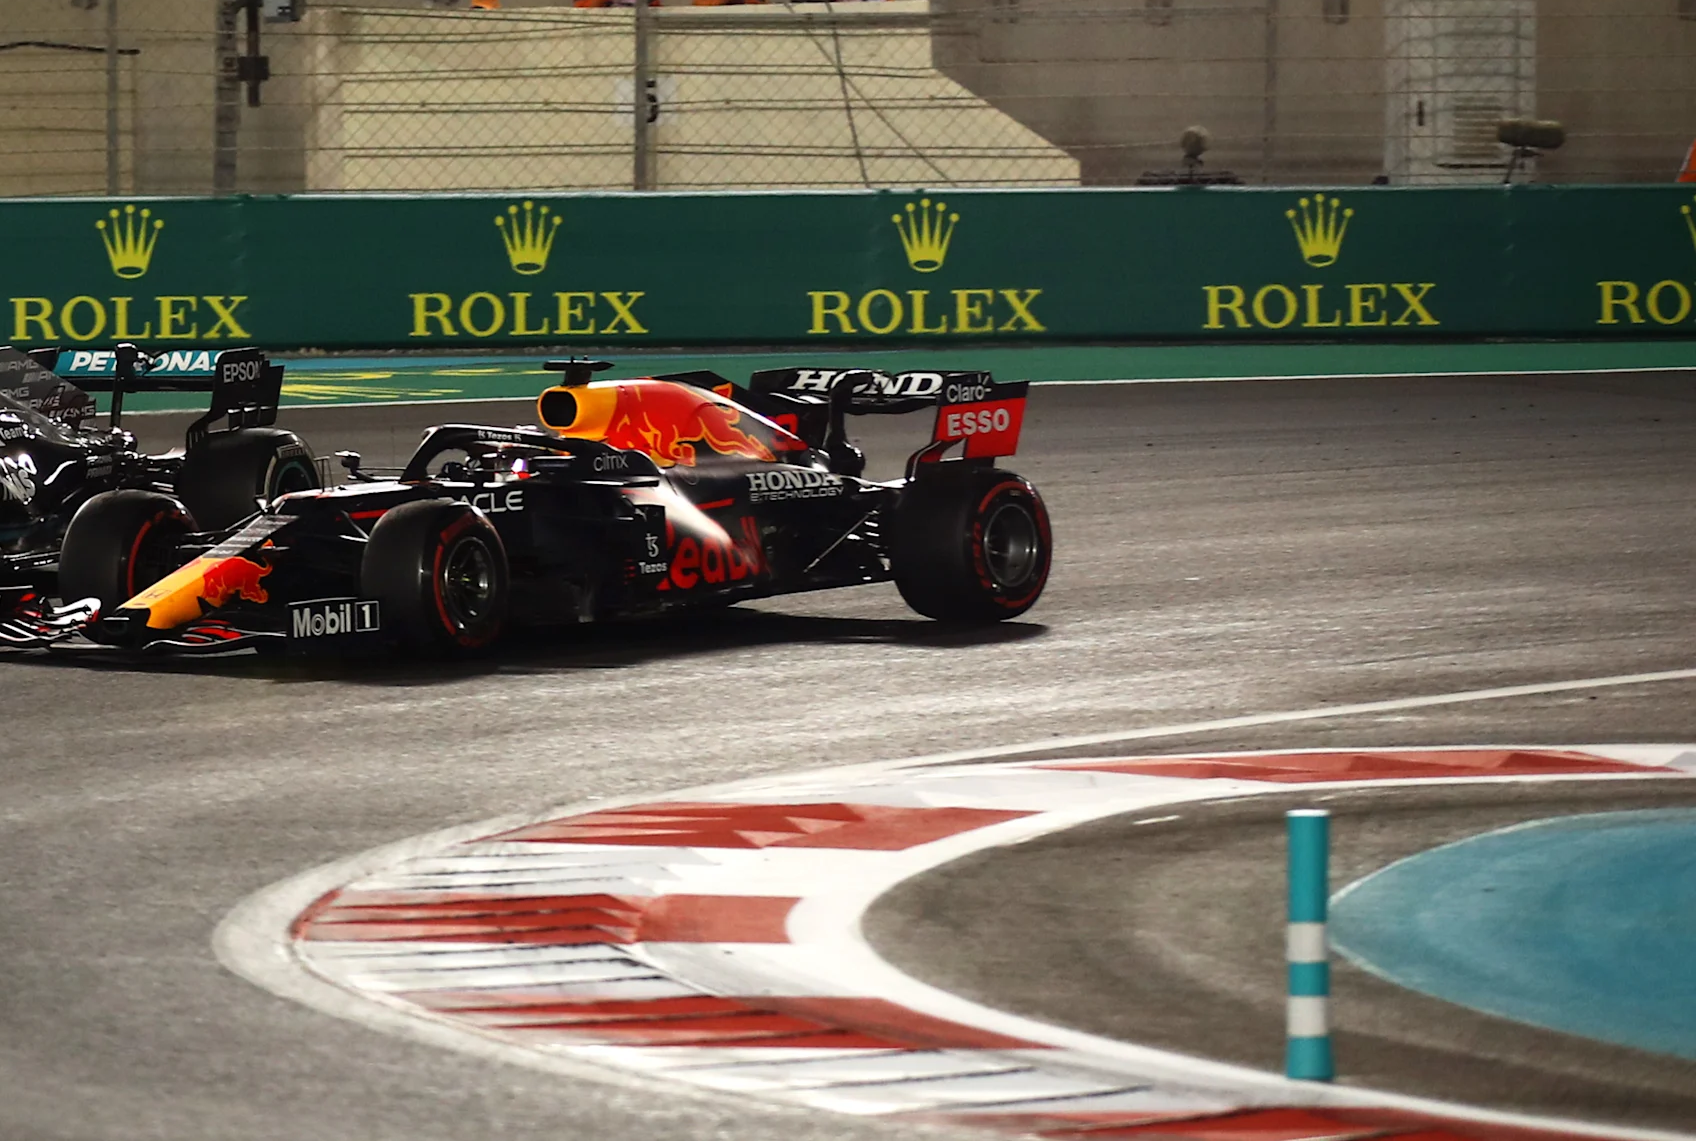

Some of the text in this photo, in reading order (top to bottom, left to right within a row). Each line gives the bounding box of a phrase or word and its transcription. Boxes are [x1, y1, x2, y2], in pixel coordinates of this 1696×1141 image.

[10, 296, 252, 341] ROLEX
[409, 291, 649, 337] ROLEX
[807, 287, 1046, 334] ROLEX
[1202, 282, 1441, 328] ROLEX
[1596, 279, 1696, 325] RO
[222, 359, 262, 384] EPSON
[946, 408, 1010, 437] ESSO
[745, 470, 843, 492] HONDA
[639, 561, 668, 574] Tezos
[292, 603, 372, 639] Mobil 1
